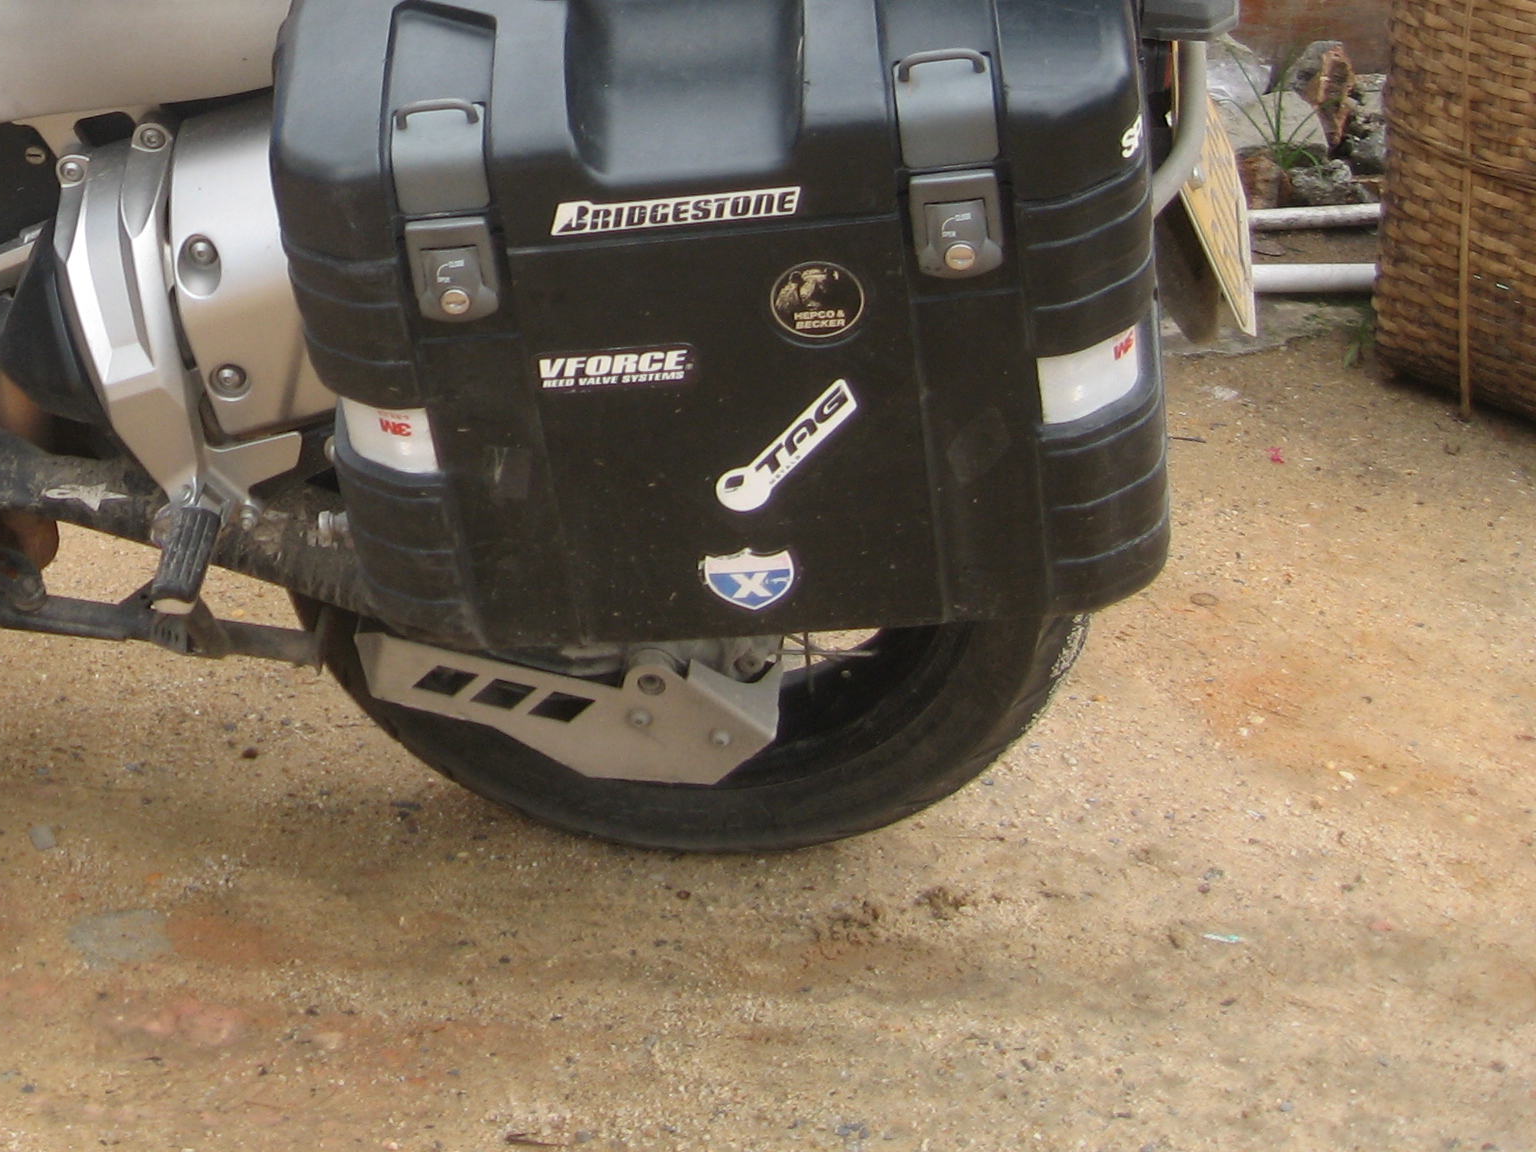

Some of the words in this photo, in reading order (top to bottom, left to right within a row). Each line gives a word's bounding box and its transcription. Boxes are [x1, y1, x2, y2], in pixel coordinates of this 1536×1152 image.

[555, 190, 797, 234] BRIDGESTONE
[793, 309, 836, 321] HEPCO
[836, 309, 846, 318] &
[795, 318, 846, 330] BECKER
[538, 349, 688, 379] VFORCE
[542, 378, 575, 389] REED
[578, 375, 619, 387] VALVE
[621, 370, 686, 384] SYSTEMS
[378, 417, 412, 437] 3M
[754, 384, 849, 474] TAG
